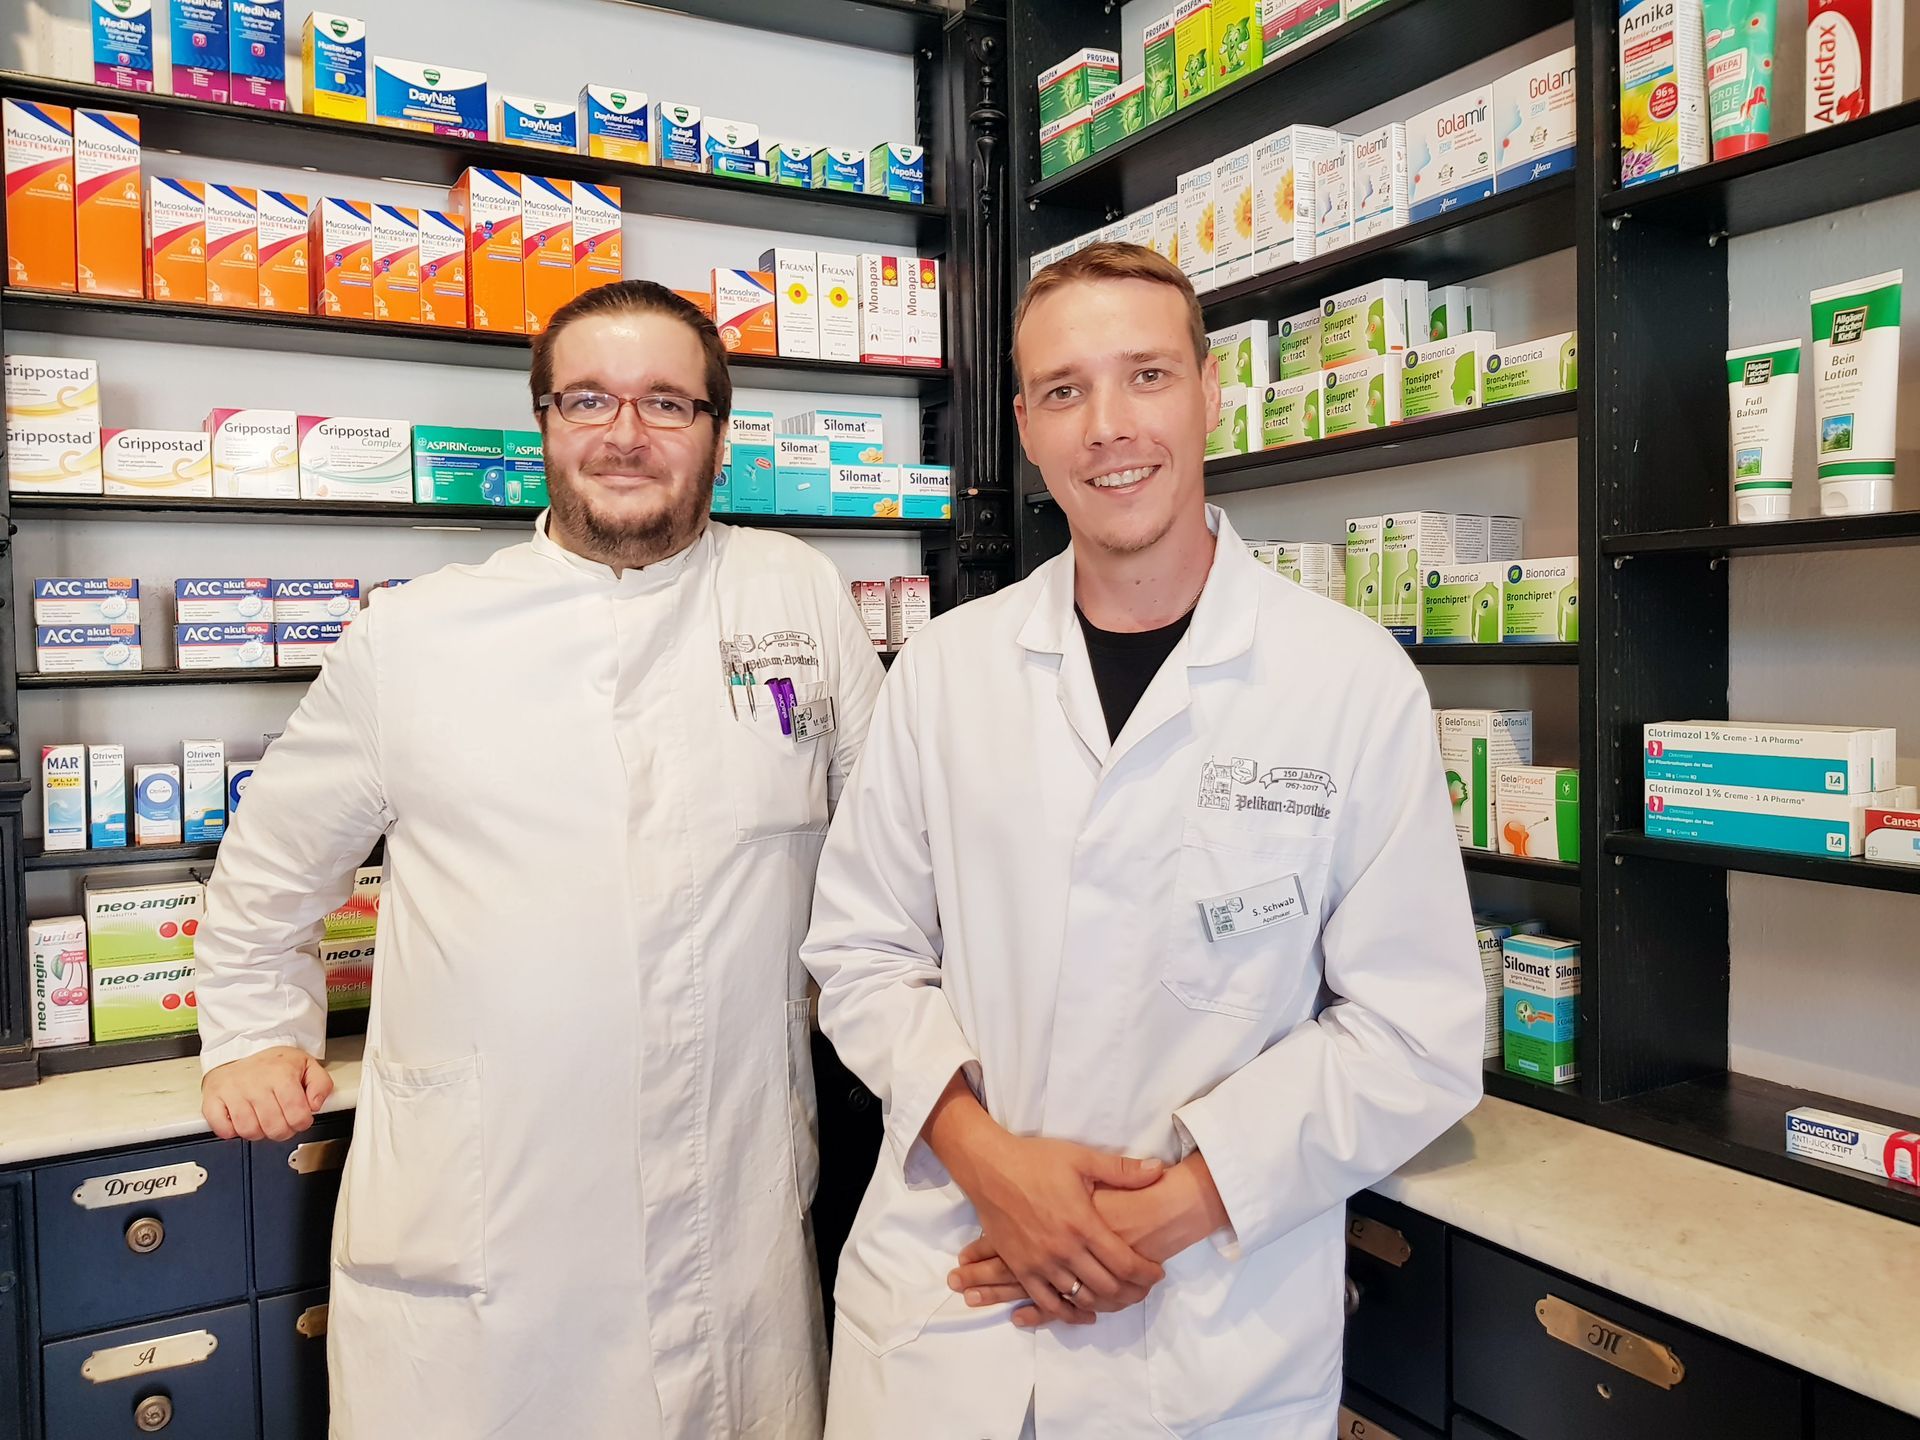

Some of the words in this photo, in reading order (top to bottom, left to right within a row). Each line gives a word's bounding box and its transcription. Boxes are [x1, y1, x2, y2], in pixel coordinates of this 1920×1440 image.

[233, 2, 281, 20] MediNait
[100, 16, 146, 33] MediNait
[1623, 3, 1673, 34] Arnika
[1145, 19, 1170, 40] PROSPAN
[1086, 52, 1115, 64] PROSPAN
[1716, 58, 1739, 73] WEPA
[1039, 68, 1058, 84] PROSPAN
[1814, 24, 1837, 124] Antistax
[409, 88, 456, 106] DayNait
[1094, 91, 1117, 109] PROSPAN
[519, 116, 562, 132] DayMed
[594, 111, 623, 124] DayMed
[623, 115, 644, 126] Kombi
[1437, 100, 1488, 138] Golamir
[7, 128, 70, 147] Mucosolvan
[1040, 123, 1061, 139] PROSPAN
[7, 138, 70, 154] HUSTENSAFT
[78, 139, 139, 156] Mucosolvan
[1357, 132, 1389, 159] Golamir
[78, 150, 139, 163] HUSTENSAFT
[1318, 149, 1347, 176] Golamir
[783, 159, 809, 171] VapoRub
[832, 163, 858, 175] VapoRub
[1260, 156, 1286, 172] HUSTEN
[890, 165, 923, 179] VapoRub
[1220, 175, 1245, 189] HUSTEN
[472, 192, 521, 207] Mucosolvan
[1184, 191, 1207, 205] HUSTEN
[154, 200, 204, 213] Mucosolvan
[207, 206, 255, 219] Mucosolvan
[524, 200, 571, 213] Mucosolvan
[574, 206, 621, 220] Mucosolvan
[154, 208, 204, 220] HUSTENSAFT
[207, 215, 255, 225] HUSTENSAFT
[260, 212, 307, 225] Mucosolvan
[260, 220, 307, 231] HUSTENSAFT
[326, 220, 370, 232] Mucosolvan
[374, 226, 418, 239] Mucosolvan
[421, 231, 464, 244] Mucosolvan
[780, 259, 814, 273] FAGUSAN
[821, 263, 855, 277] FAGUSAN
[719, 285, 760, 298] Mucosolvan
[868, 256, 879, 314] Monapax
[906, 259, 916, 316] Monapax
[1337, 294, 1367, 310] Bionorica
[882, 306, 900, 315] Sirup
[921, 309, 938, 318] Sirup
[1293, 316, 1320, 331] Bionorica
[1324, 315, 1355, 332] Sinupret
[1212, 332, 1238, 347] Bionorica
[1324, 329, 1351, 345] extract
[1281, 337, 1310, 352] Sinupret
[1282, 349, 1306, 363] extract
[1421, 346, 1456, 362] Bionorica
[1504, 350, 1543, 366] Bionorica
[1831, 354, 1855, 367] Bein
[1339, 369, 1367, 383] Bionorica
[1405, 370, 1440, 386] Tonsipret
[1486, 371, 1525, 385] Bronchipret
[1824, 368, 1858, 381] Lotion
[1276, 384, 1304, 397] Bionorica
[1405, 384, 1432, 395] Tabletten
[1486, 380, 1508, 392] Thymian
[1326, 388, 1356, 404] Sinupret
[1264, 403, 1293, 417] Sinupret
[1326, 402, 1352, 416] extract
[1736, 407, 1768, 418] Balsam
[224, 422, 292, 436] Grippostad
[733, 419, 771, 432] Silomat
[823, 418, 866, 433] Silomat
[1265, 416, 1289, 429] extract
[318, 423, 391, 439] Grippostad
[118, 436, 204, 453] Grippostad
[361, 437, 402, 449] Complex
[427, 440, 467, 453] ASPIRIN
[467, 446, 502, 454] COMPLEX
[780, 441, 818, 454] Silomat
[839, 469, 882, 483] Silomat
[910, 472, 949, 486] Silomat
[1347, 538, 1376, 547] Bronchipret
[1384, 534, 1415, 543] Bronchipret
[1443, 572, 1480, 583] Bionorica
[1525, 568, 1567, 579] Bionorica
[41, 582, 82, 596] ACC
[84, 581, 106, 589] akut
[184, 581, 222, 596] ACC
[224, 580, 245, 589] akut
[276, 582, 311, 596] ACC
[313, 582, 333, 590] akut
[1425, 595, 1469, 606] Bronchipret
[1506, 590, 1553, 603] Bronchipret
[1506, 603, 1514, 611] TP
[44, 629, 84, 644] ACC
[86, 628, 110, 636] akut
[184, 626, 222, 641] ACC
[224, 626, 245, 634] akut
[283, 625, 319, 640] ACC
[321, 624, 342, 633] akut
[1445, 717, 1482, 727] GeloTonsil
[1492, 717, 1528, 728] GeloTonsil
[1648, 728, 1702, 740] Clotrimazol
[1704, 731, 1721, 741] 1%
[1723, 734, 1747, 743] Creme
[1769, 736, 1800, 745] Pharma
[92, 752, 123, 760] Otriven
[186, 750, 221, 759] Otriven
[47, 757, 79, 770] MAR
[1283, 770, 1297, 778] 250
[1300, 770, 1324, 782] Jahre
[1500, 774, 1543, 785] GeloProsed
[1828, 775, 1841, 785] 1A
[1648, 783, 1703, 796] Clotrimazol
[1705, 786, 1722, 797] 1%
[1724, 790, 1748, 800] Creme
[1770, 795, 1802, 805] Pharma
[1883, 815, 1920, 828] Canest
[1829, 836, 1842, 846] 1A
[1252, 908, 1262, 917] S.
[1263, 897, 1295, 914] Schwab
[35, 931, 83, 946] junior
[1504, 955, 1551, 978] Silomat
[1791, 1118, 1853, 1143] Soventol
[1791, 1133, 1831, 1149] ANTI-JUCK
[1831, 1143, 1853, 1155] STIFT
[104, 1174, 178, 1197] Drogen
[1587, 1323, 1622, 1355] M
[133, 1347, 157, 1367] A
